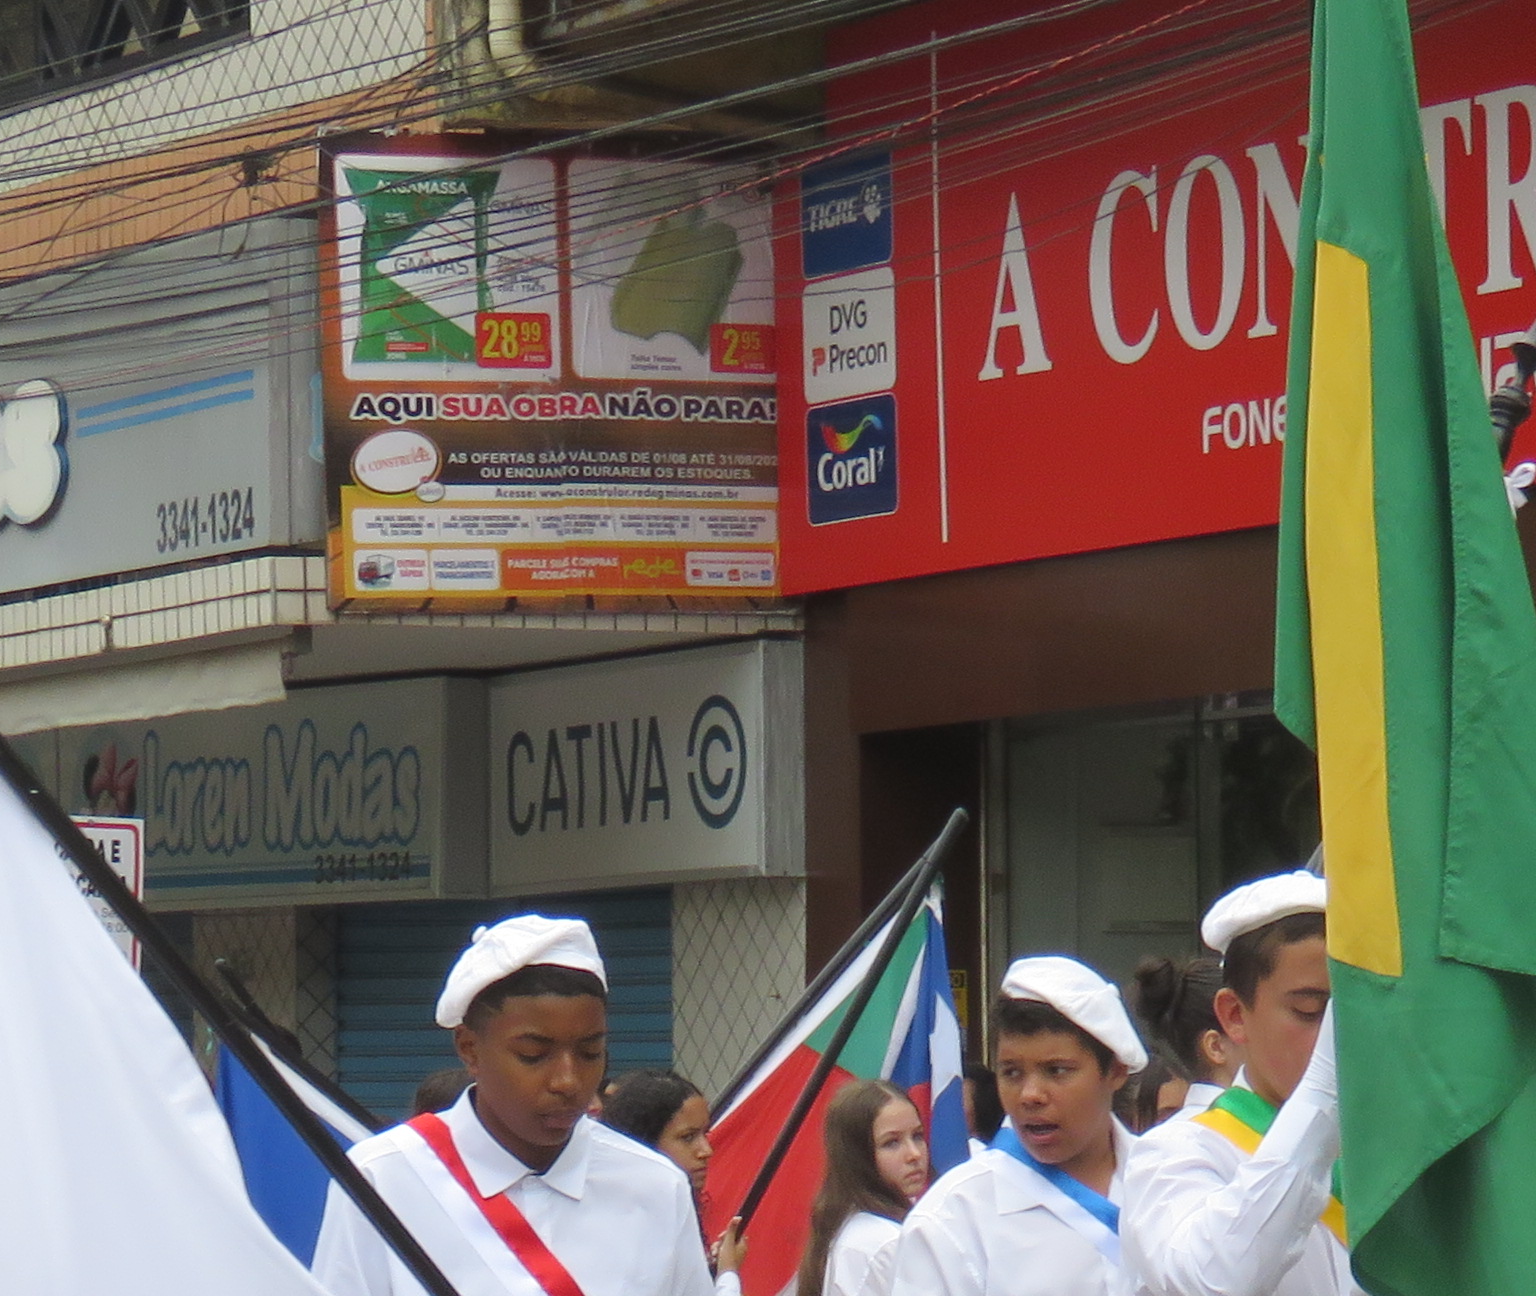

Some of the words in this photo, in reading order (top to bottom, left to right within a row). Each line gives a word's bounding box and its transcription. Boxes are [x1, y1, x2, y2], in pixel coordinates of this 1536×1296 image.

[977, 191, 1053, 382] A
[829, 300, 867, 335] DVG
[829, 340, 888, 374] Precon
[352, 395, 435, 421] AQUI
[441, 395, 508, 418] SUA
[512, 394, 602, 418] OBRA
[608, 390, 678, 418] NÃO
[683, 398, 777, 421] PARA!
[448, 453, 468, 464] AS
[471, 453, 535, 464] OFERTAS
[631, 453, 649, 463] DE
[480, 467, 501, 479] OU
[505, 466, 580, 479] ENQUANTO
[583, 467, 652, 478] DURAREM
[654, 467, 674, 478] OS
[817, 453, 878, 494] Coral
[156, 486, 255, 553] 3341-1324
[264, 718, 420, 850] Modas
[507, 715, 670, 836] CATIVA
